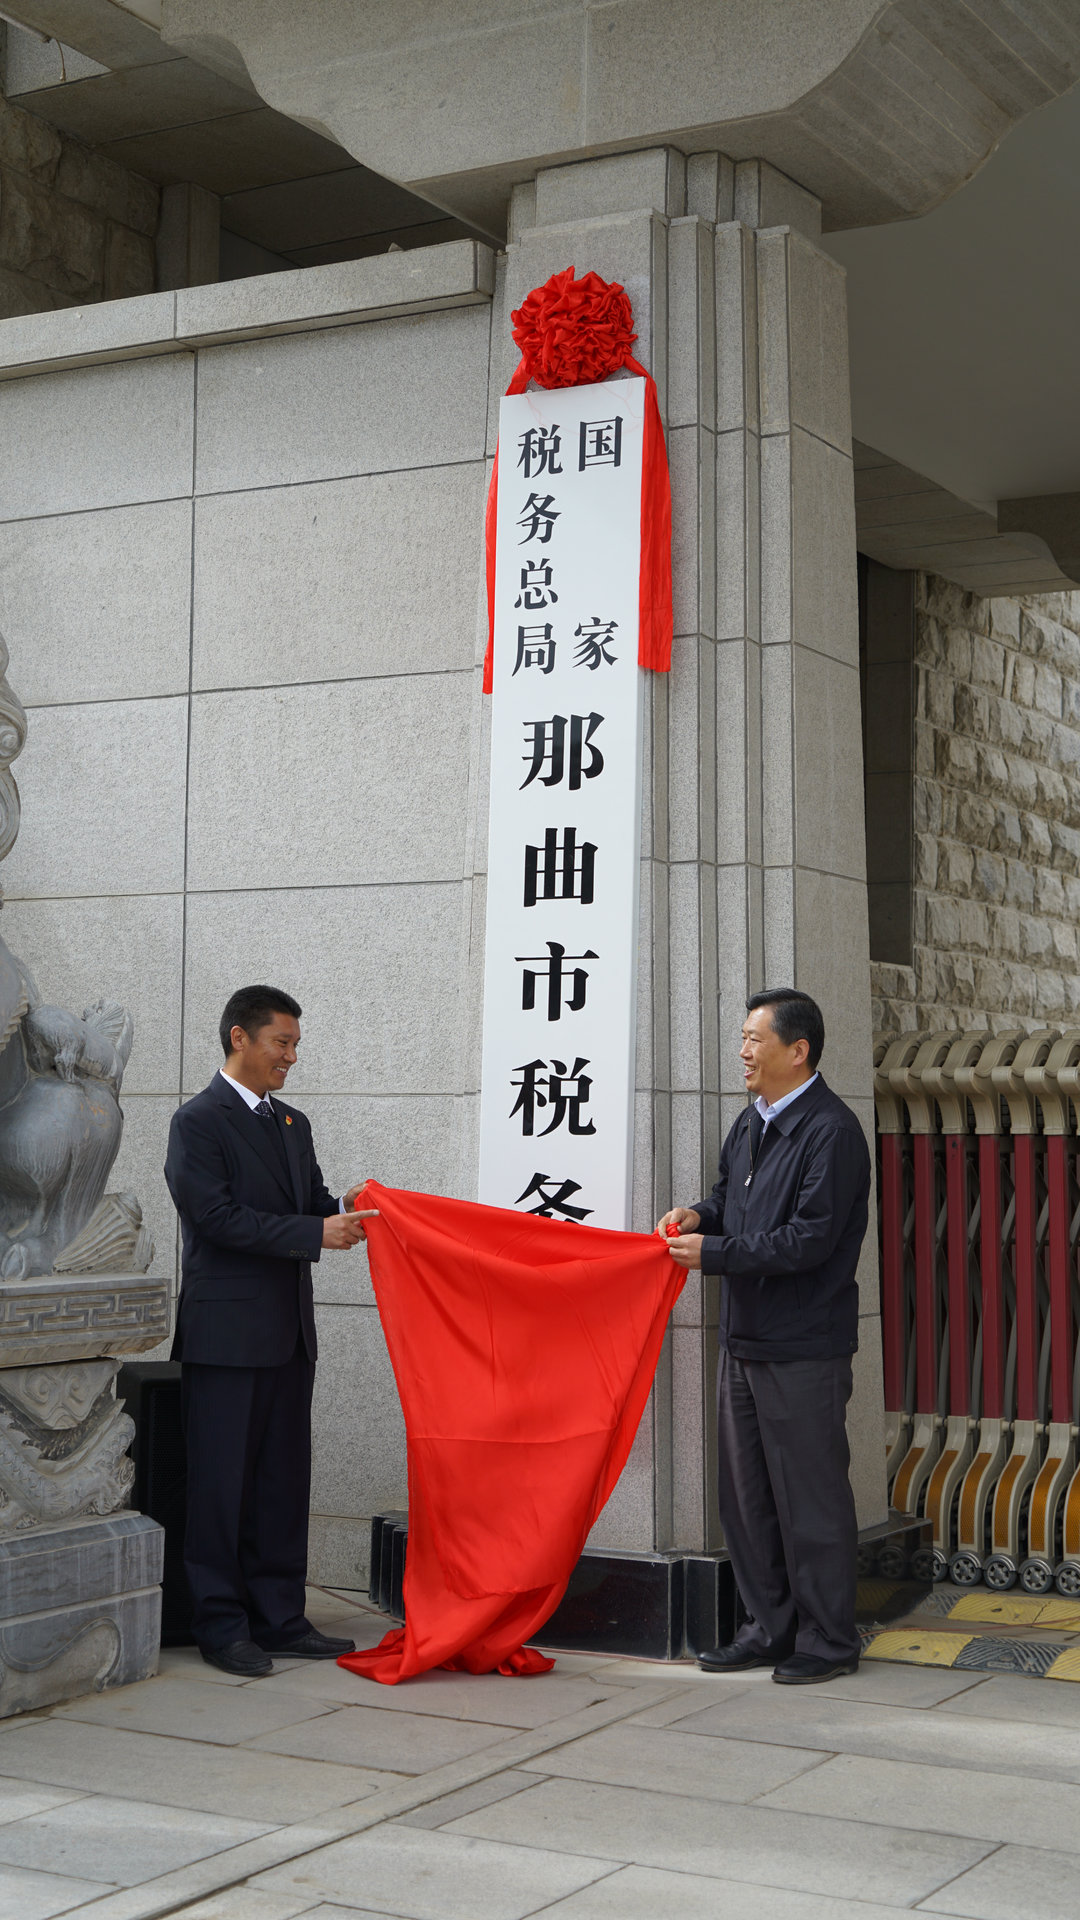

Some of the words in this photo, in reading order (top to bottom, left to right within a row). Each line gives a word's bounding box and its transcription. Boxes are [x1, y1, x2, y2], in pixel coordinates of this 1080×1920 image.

[511, 423, 564, 677] 税务总局
[573, 415, 624, 672] 国家
